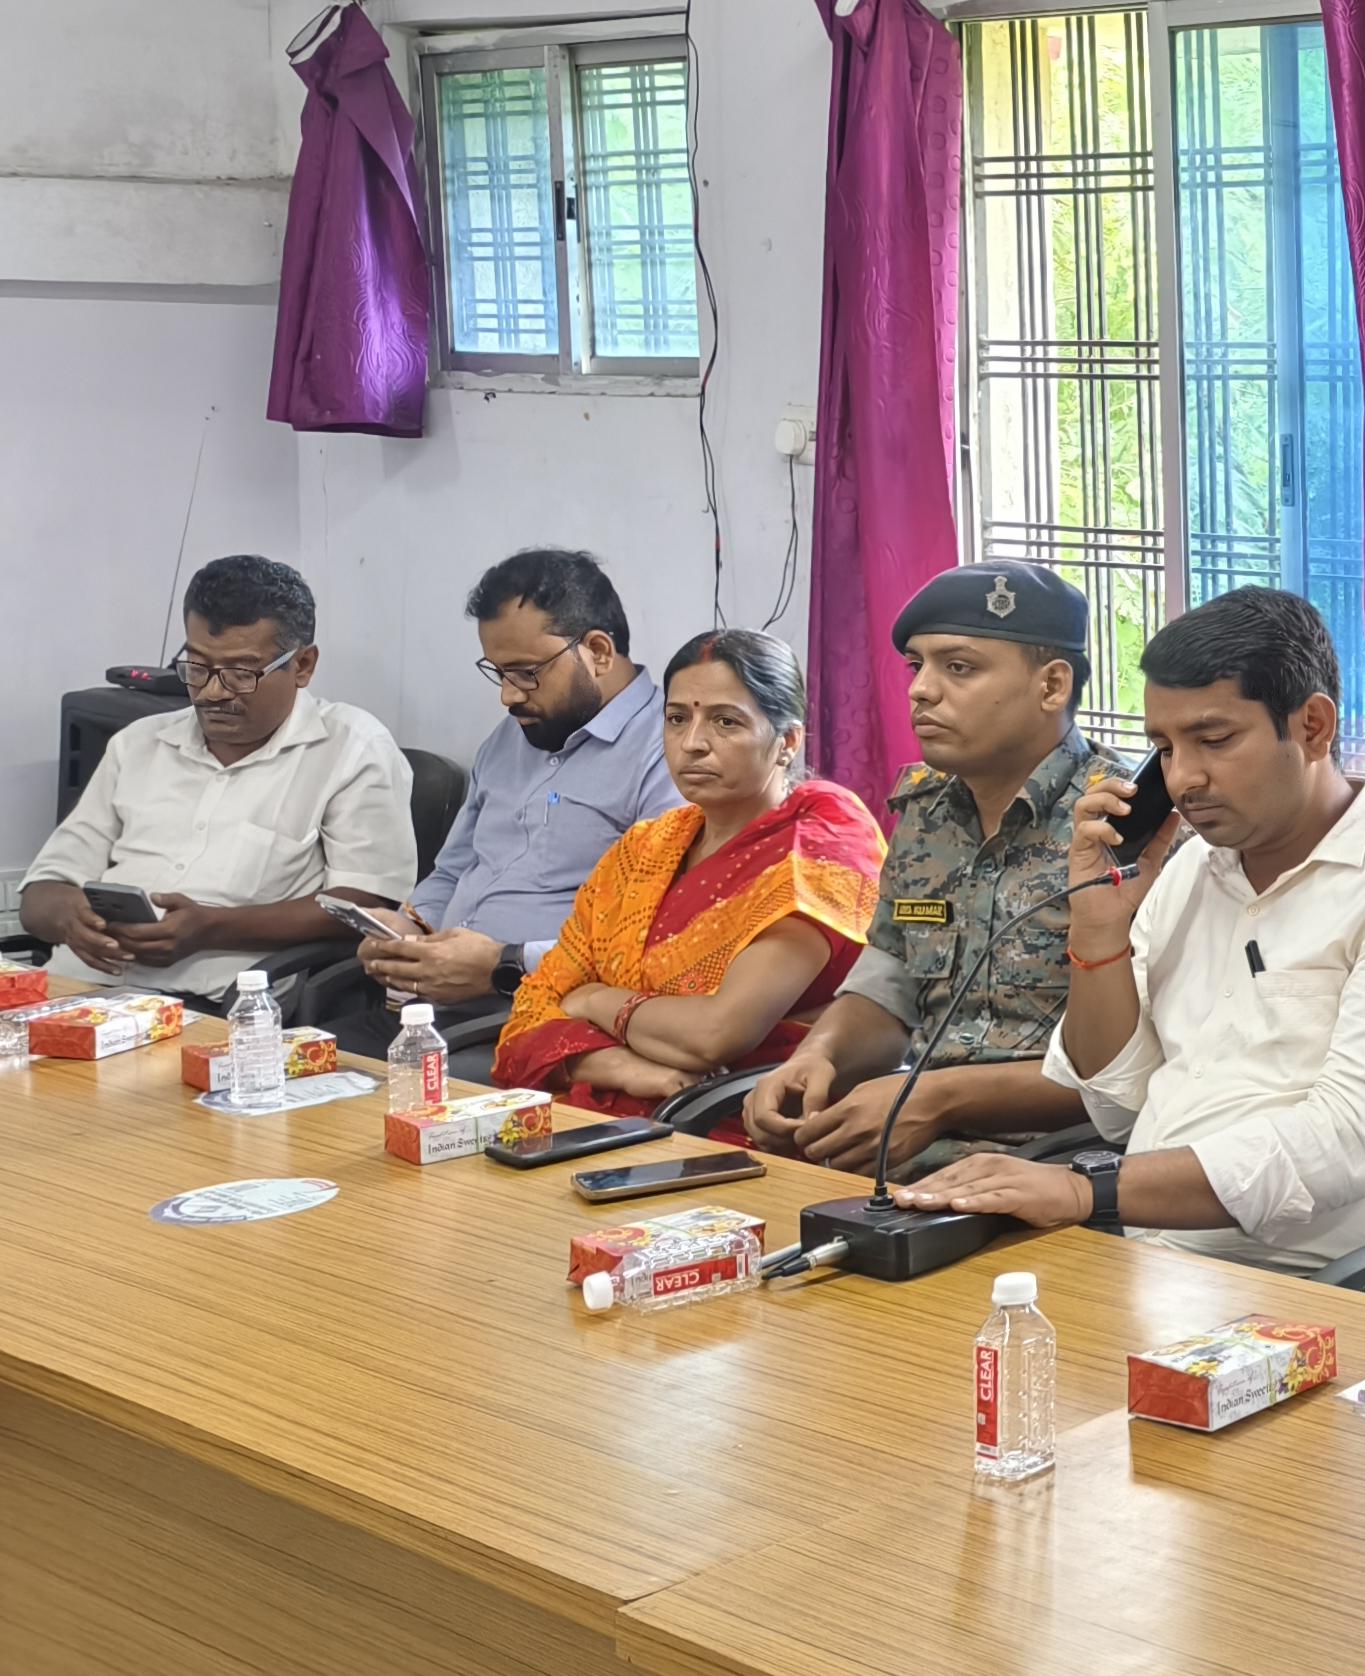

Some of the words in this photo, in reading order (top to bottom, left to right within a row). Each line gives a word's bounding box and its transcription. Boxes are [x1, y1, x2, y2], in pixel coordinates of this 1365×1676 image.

[426, 1054, 439, 1091] CLEAR
[428, 1139, 456, 1154] Indian
[656, 1270, 700, 1292] CLEAR
[980, 1350, 994, 1402] CLEAR
[1217, 1397, 1244, 1415] Indian
